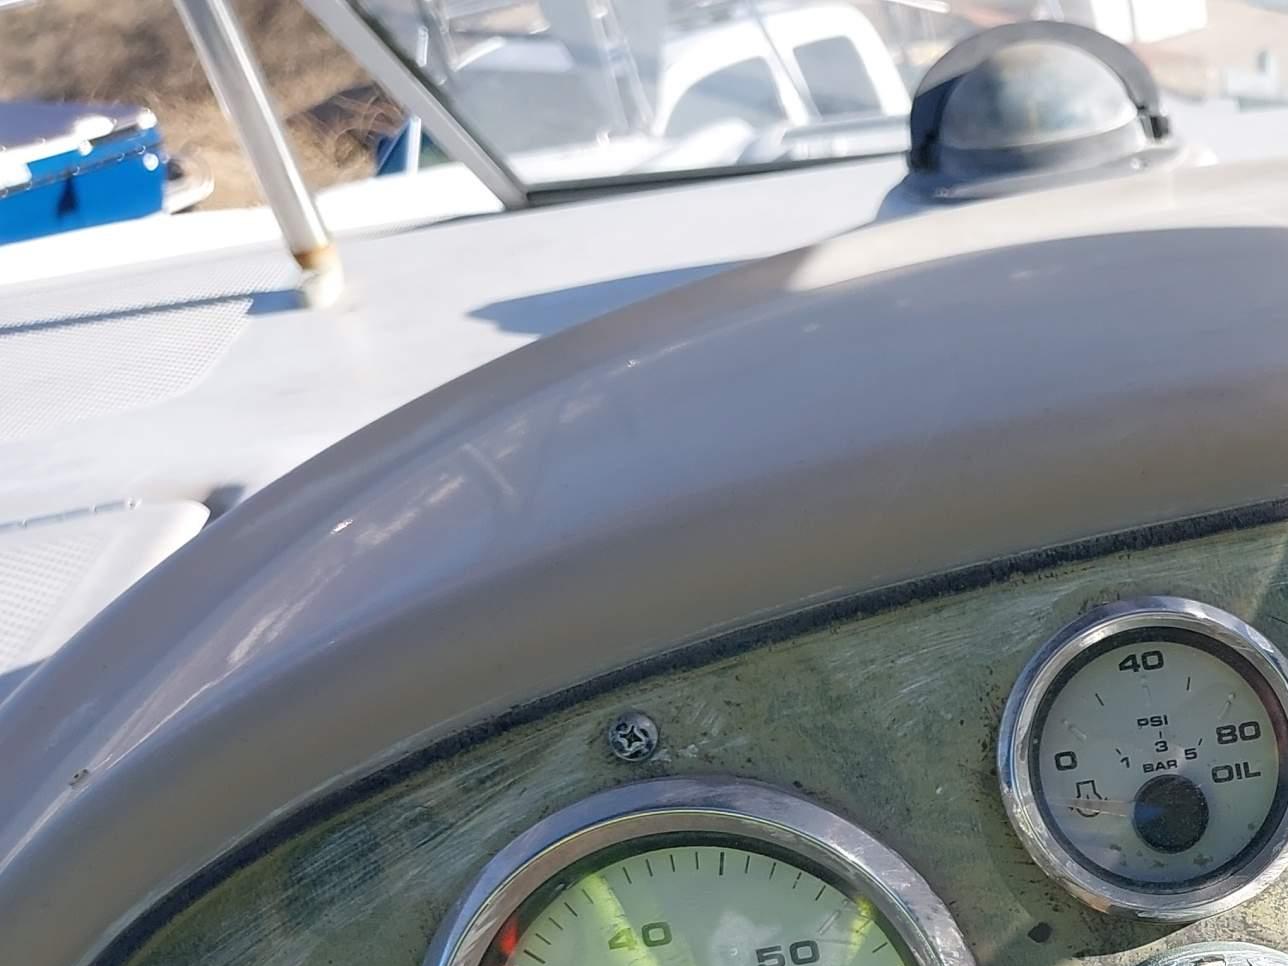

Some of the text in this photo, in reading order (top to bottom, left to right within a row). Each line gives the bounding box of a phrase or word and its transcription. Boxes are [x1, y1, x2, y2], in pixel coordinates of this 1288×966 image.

[1118, 650, 1165, 673] 40
[1137, 715, 1169, 727] PSI
[1216, 721, 1262, 745] 80
[1155, 741, 1169, 753] 3
[1185, 748, 1198, 760] 5
[1054, 751, 1078, 772] 0
[1120, 757, 1130, 769] 1
[1143, 759, 1178, 774] BAR
[1211, 762, 1262, 784] OIL
[607, 921, 673, 952] 40
